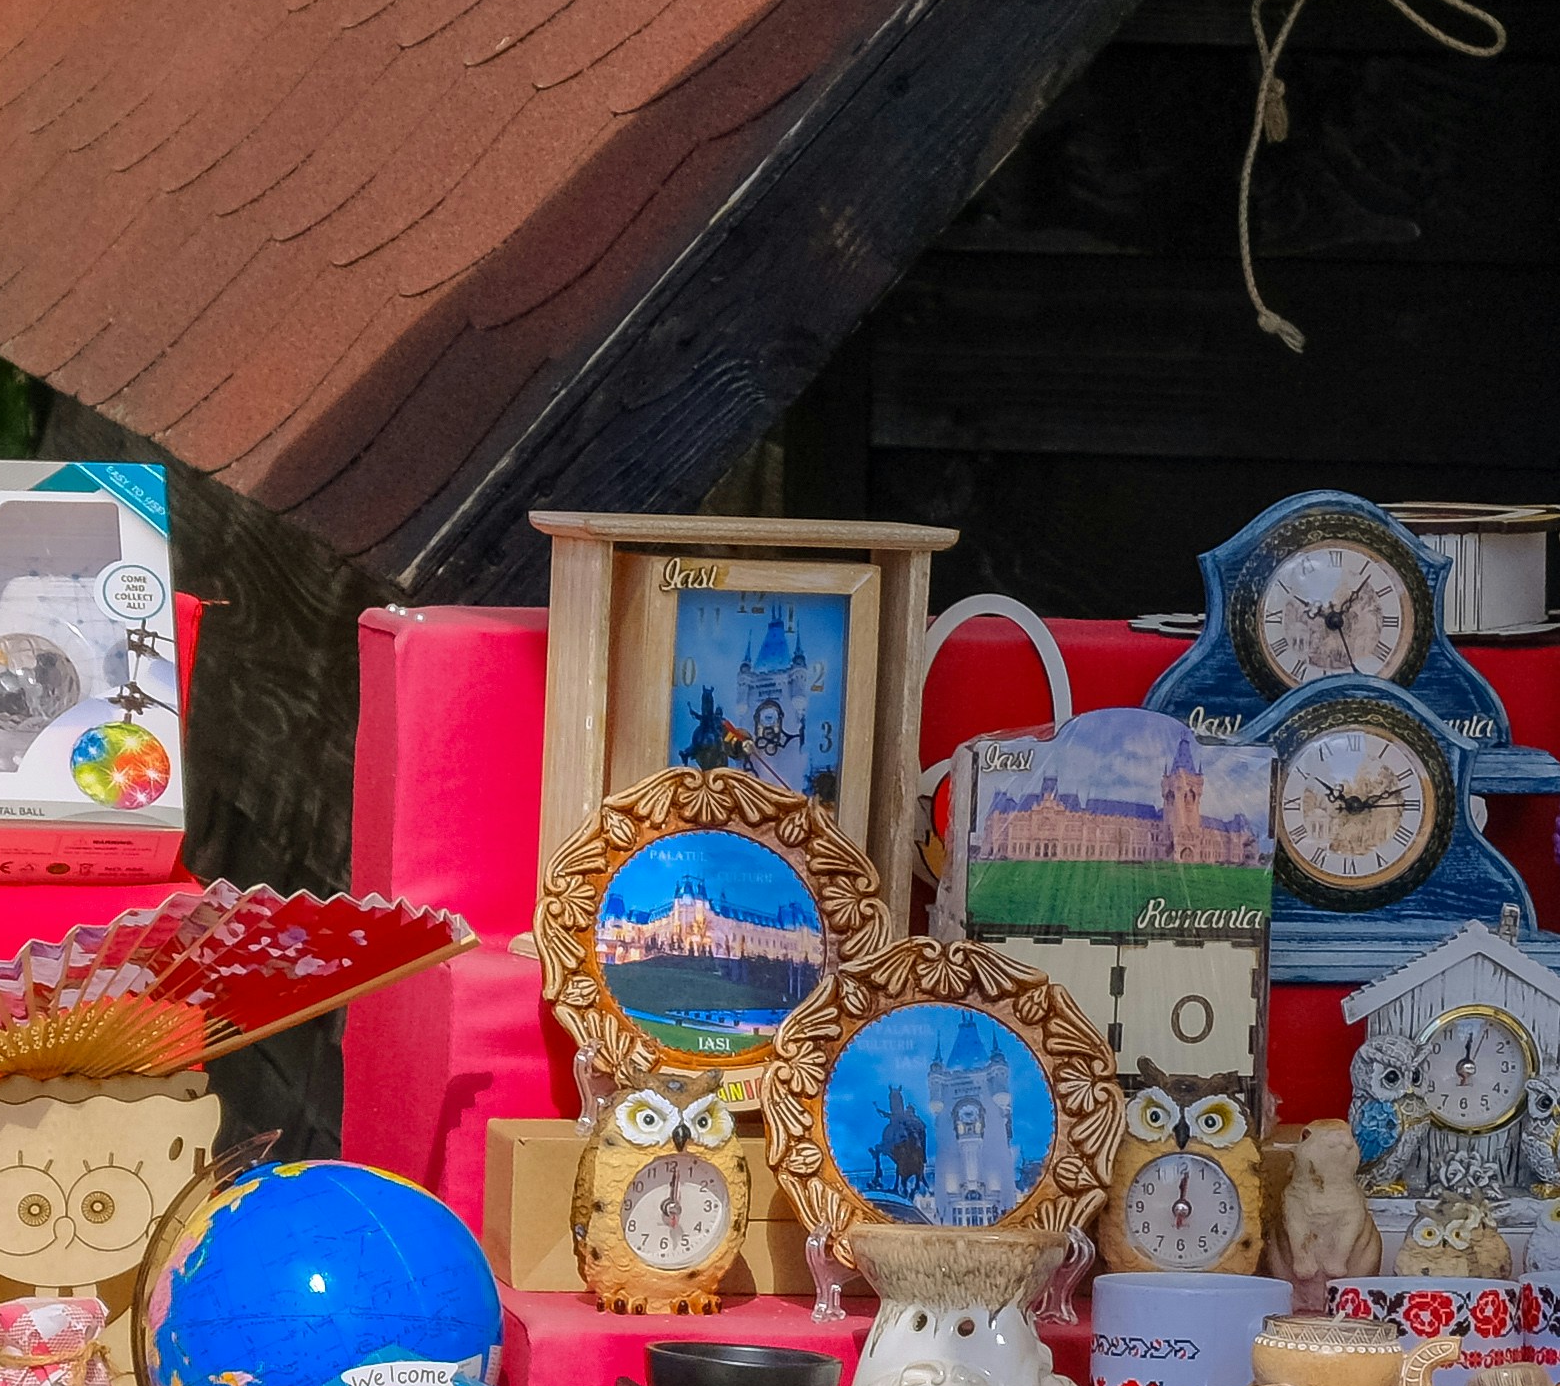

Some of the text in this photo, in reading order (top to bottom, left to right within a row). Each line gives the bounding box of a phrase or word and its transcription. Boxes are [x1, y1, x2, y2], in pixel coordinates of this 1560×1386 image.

[121, 575, 147, 584] COME
[660, 558, 718, 592] Iasi
[125, 584, 145, 592] AND
[114, 593, 153, 602] COLLECT
[819, 721, 833, 753] 3
[982, 744, 1034, 773] Iasi
[18, 806, 45, 816] BALL
[650, 850, 707, 862] PALATUL
[1137, 898, 1263, 930] Romania
[698, 1037, 731, 1051] IASI
[665, 1161, 678, 1173] 12
[647, 1168, 657, 1179] 11
[632, 1181, 644, 1193] 10
[700, 1180, 708, 1192] 2
[624, 1199, 633, 1211] 9
[703, 1200, 712, 1212] 3
[627, 1220, 636, 1232] 8
[694, 1221, 702, 1233] 4
[641, 1234, 649, 1246] 7
[660, 1237, 669, 1250] 6
[680, 1235, 689, 1247] 5
